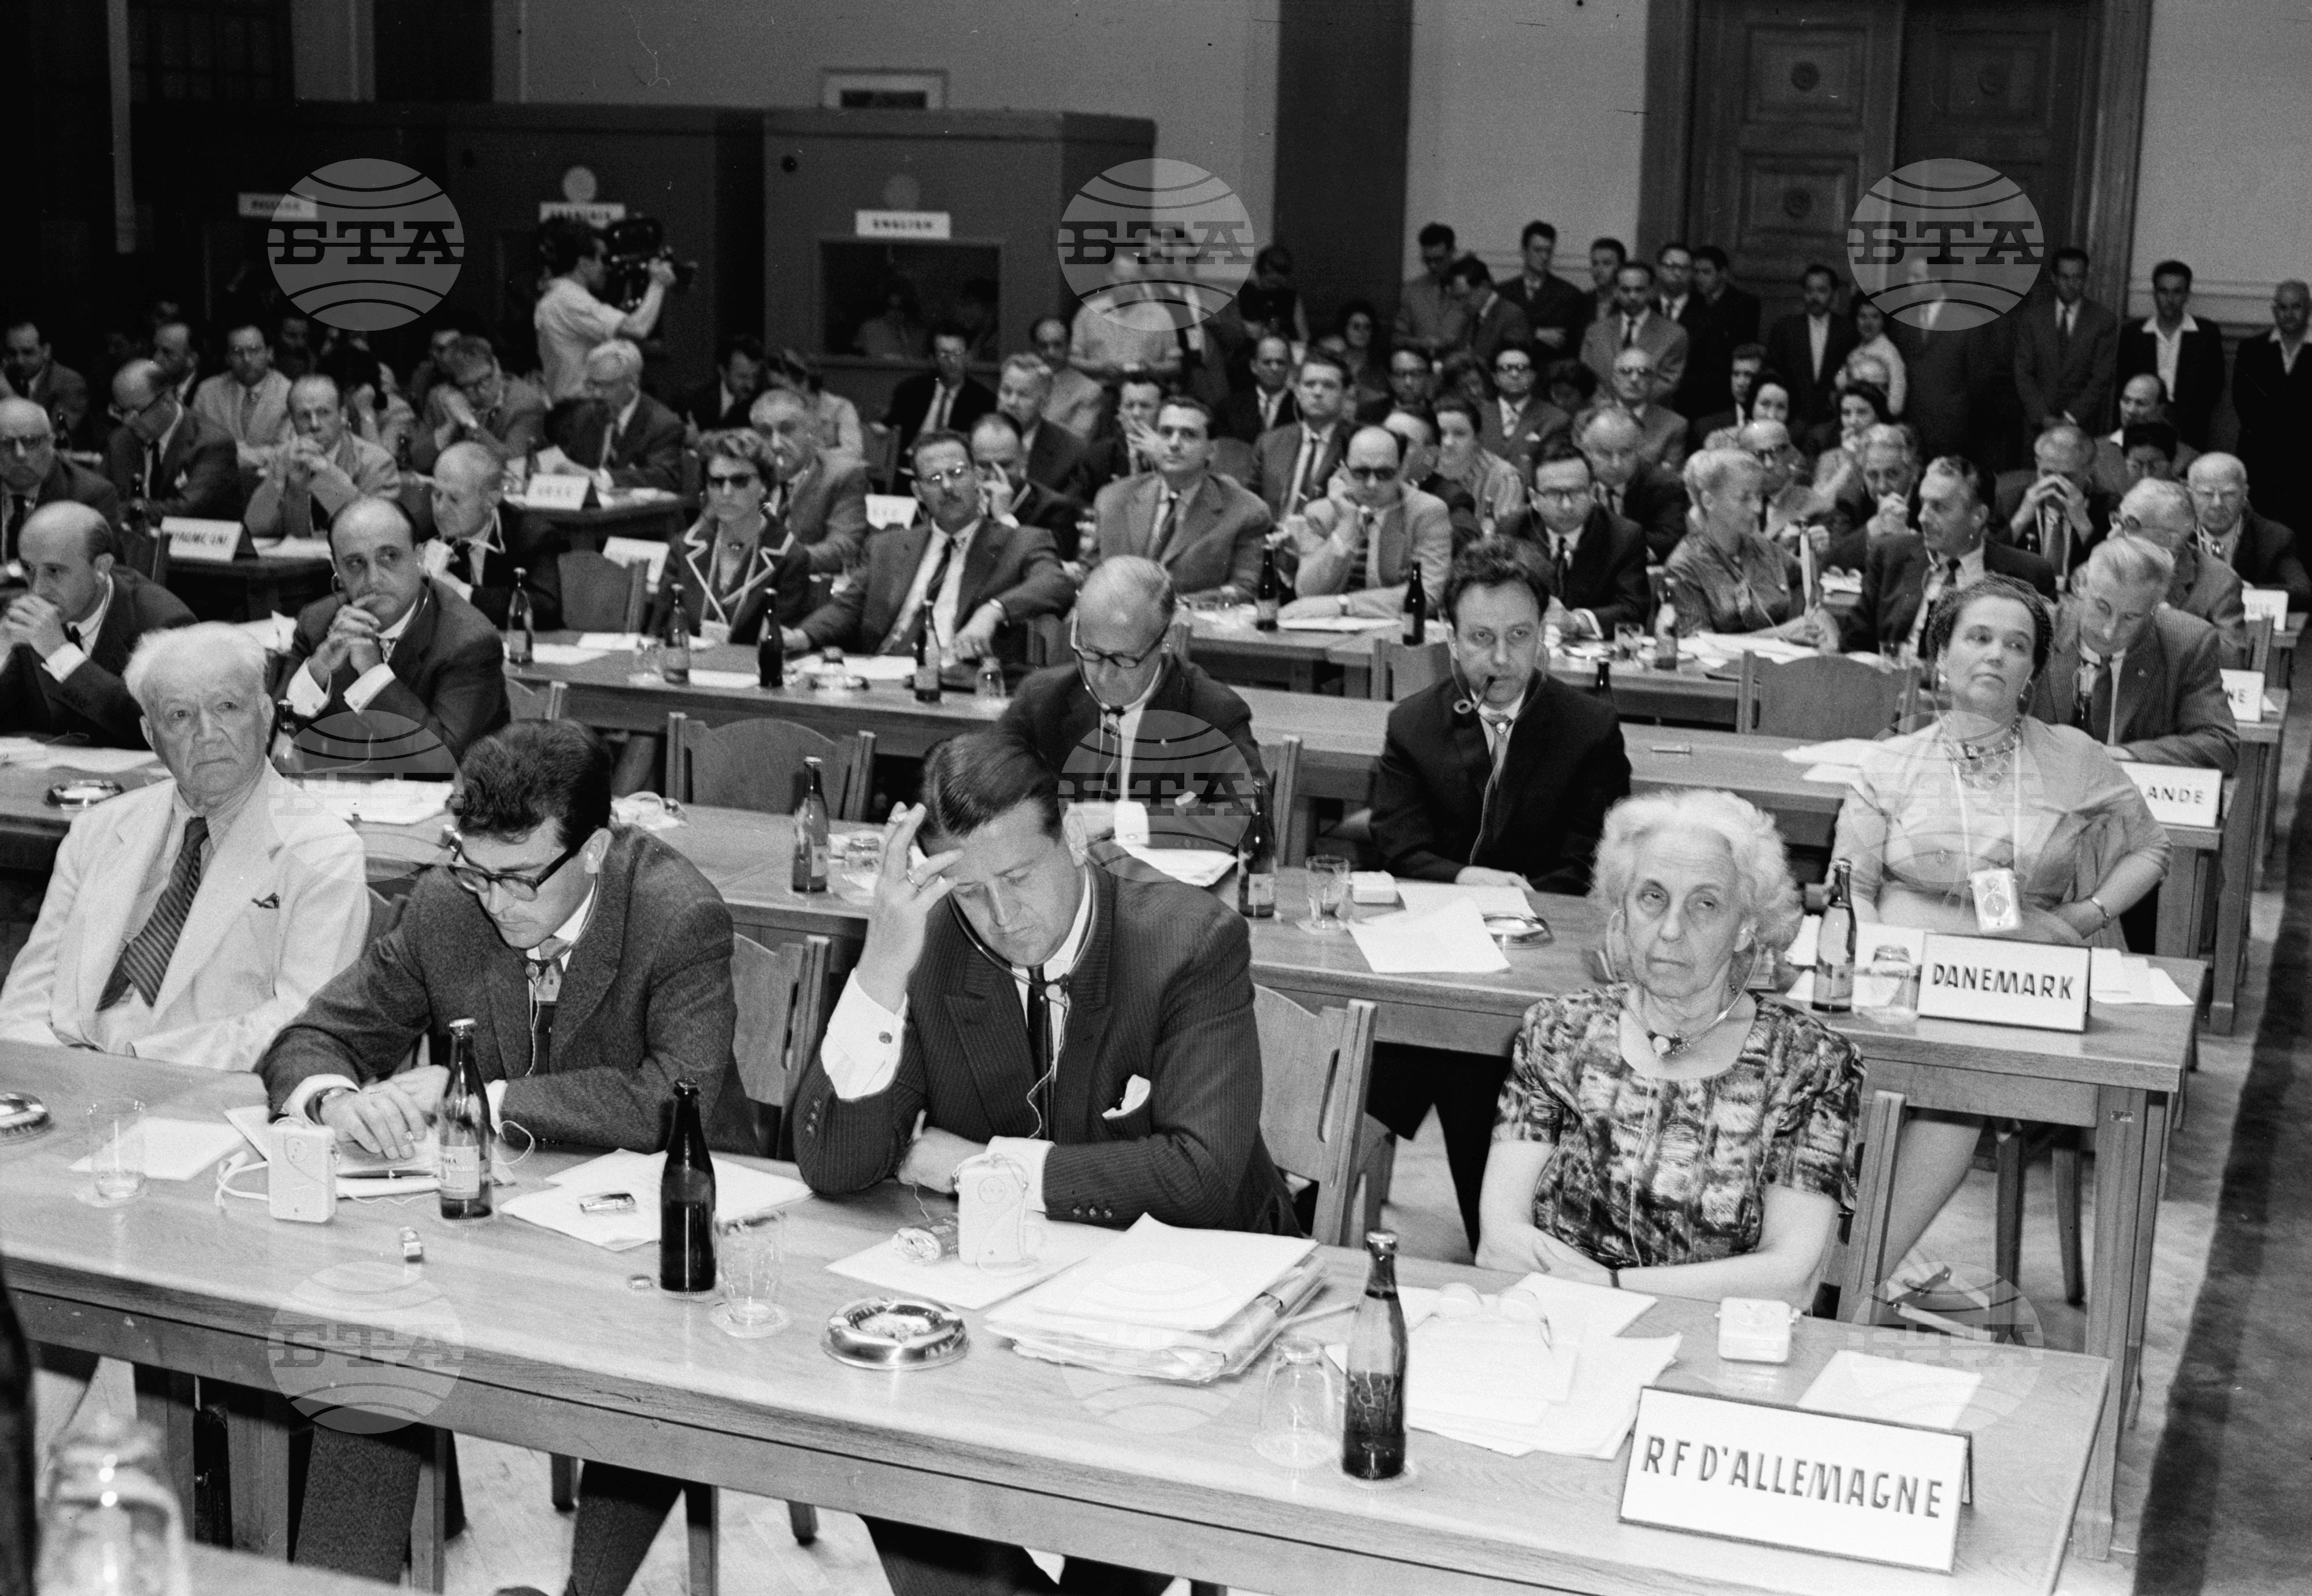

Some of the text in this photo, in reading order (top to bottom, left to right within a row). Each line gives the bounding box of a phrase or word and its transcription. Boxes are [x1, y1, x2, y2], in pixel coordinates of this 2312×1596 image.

[2228, 687, 2246, 704] NE
[2147, 785, 2205, 805] ANDE
[1931, 962, 2074, 1000] DANEMARK
[1698, 1443, 1942, 1519] D'ALLEMAGNE
